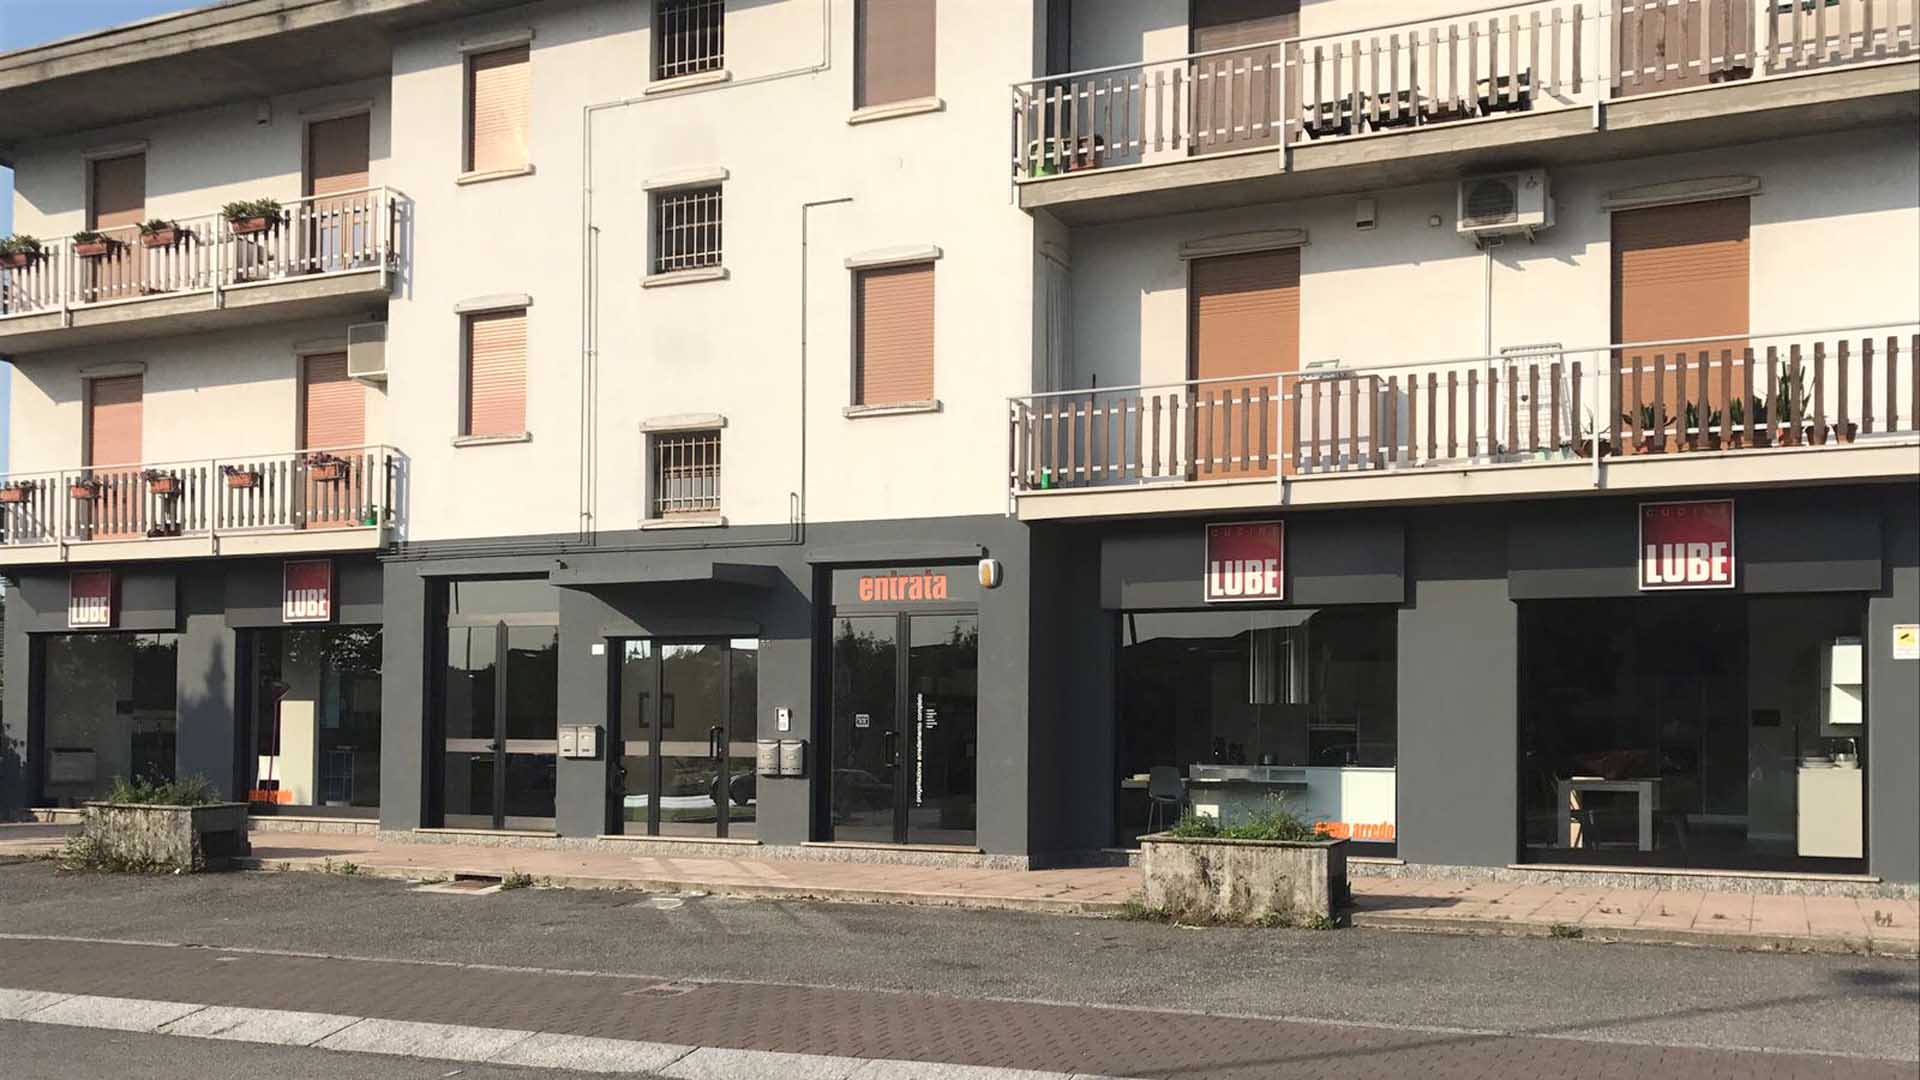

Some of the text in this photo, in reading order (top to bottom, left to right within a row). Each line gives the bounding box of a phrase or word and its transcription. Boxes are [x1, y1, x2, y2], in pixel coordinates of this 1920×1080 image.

[1210, 558, 1278, 597] LUBE
[1646, 541, 1728, 584] LUBE
[859, 571, 947, 601] entrata
[72, 596, 107, 623] LUBE
[287, 588, 327, 618] LUBE
[1353, 821, 1395, 840] arredo
